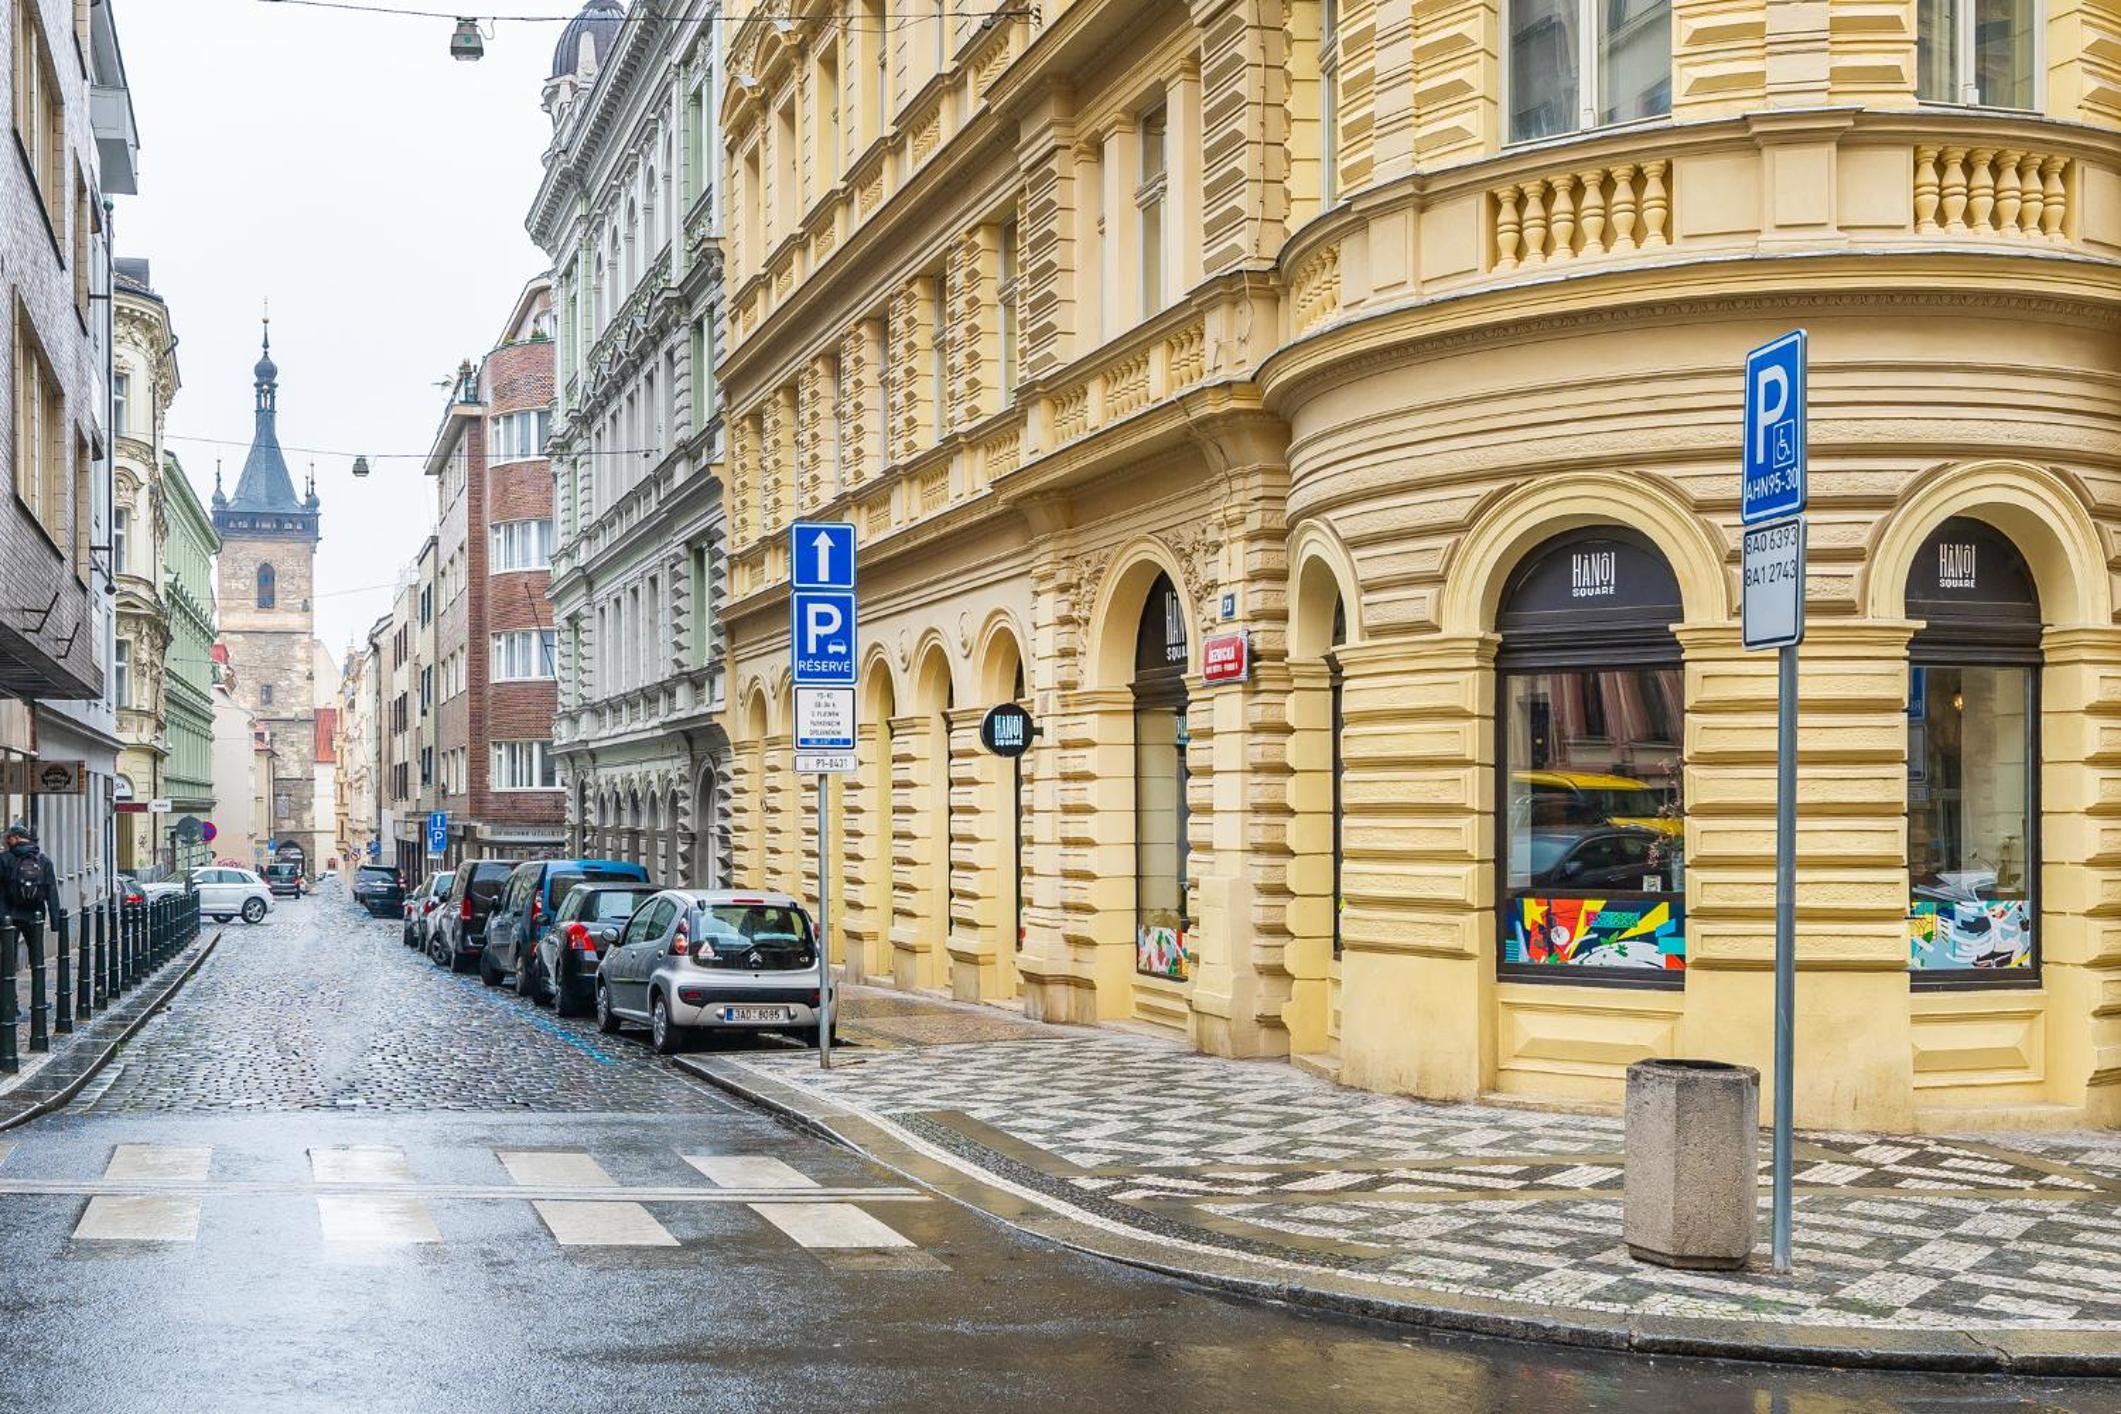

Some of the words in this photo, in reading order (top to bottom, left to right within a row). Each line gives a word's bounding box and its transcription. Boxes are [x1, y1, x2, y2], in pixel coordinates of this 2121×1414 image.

[1756, 364, 1788, 464] P
[1939, 578, 1976, 588] SQUARE
[1572, 586, 1615, 597] SQUARE
[807, 603, 842, 654] P
[1166, 646, 1188, 661] SQU
[434, 832, 443, 844] P
